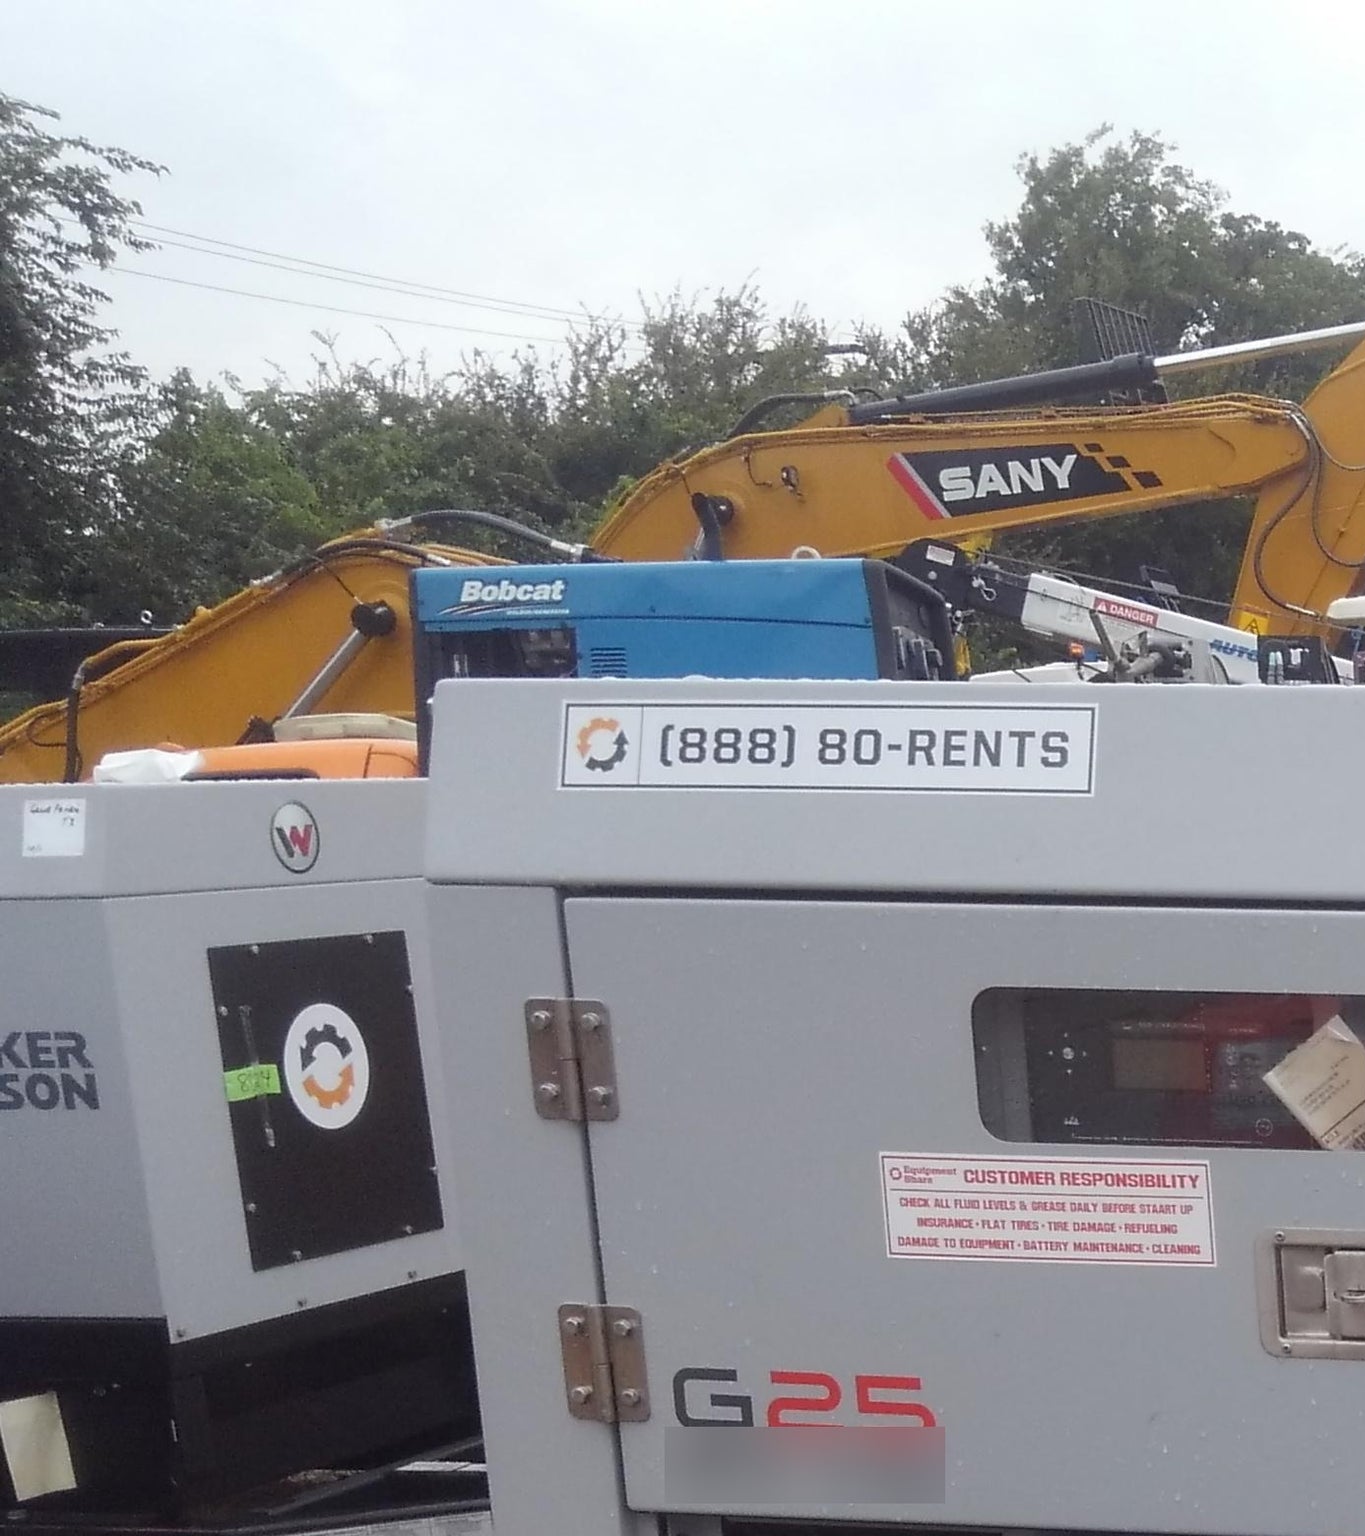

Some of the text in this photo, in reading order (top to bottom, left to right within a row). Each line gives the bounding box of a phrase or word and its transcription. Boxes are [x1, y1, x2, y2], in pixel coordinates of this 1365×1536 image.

[939, 454, 1077, 501] SANY
[461, 580, 565, 601] Bobcat
[1109, 604, 1155, 622] DANGER
[659, 725, 1070, 768] (888) 80-RENTS
[0, 1031, 94, 1069] KER
[0, 1073, 100, 1110] SON
[904, 1165, 956, 1176] Equipment
[904, 1175, 933, 1184] Share
[964, 1169, 1199, 1189] CUSTOMER RESPONSIBILITY
[899, 1197, 929, 1208] CHECK
[934, 1198, 951, 1209] ALL
[954, 1199, 980, 1210] FLUID
[983, 1200, 1016, 1211] LEVELS
[1031, 1201, 1066, 1212] GREASE
[1070, 1202, 1099, 1213] DAILY
[1102, 1203, 1136, 1214] BEFORE
[1180, 1205, 1193, 1215] UP
[917, 1217, 1178, 1234] INSURANCE FLAT TIRES TIRE DAMAGE REFUELING
[898, 1236, 1200, 1255] DAMAGE TO EQUIPMENT BATTERY MAINTENANCE CLEANING
[673, 1367, 936, 1427] G25
